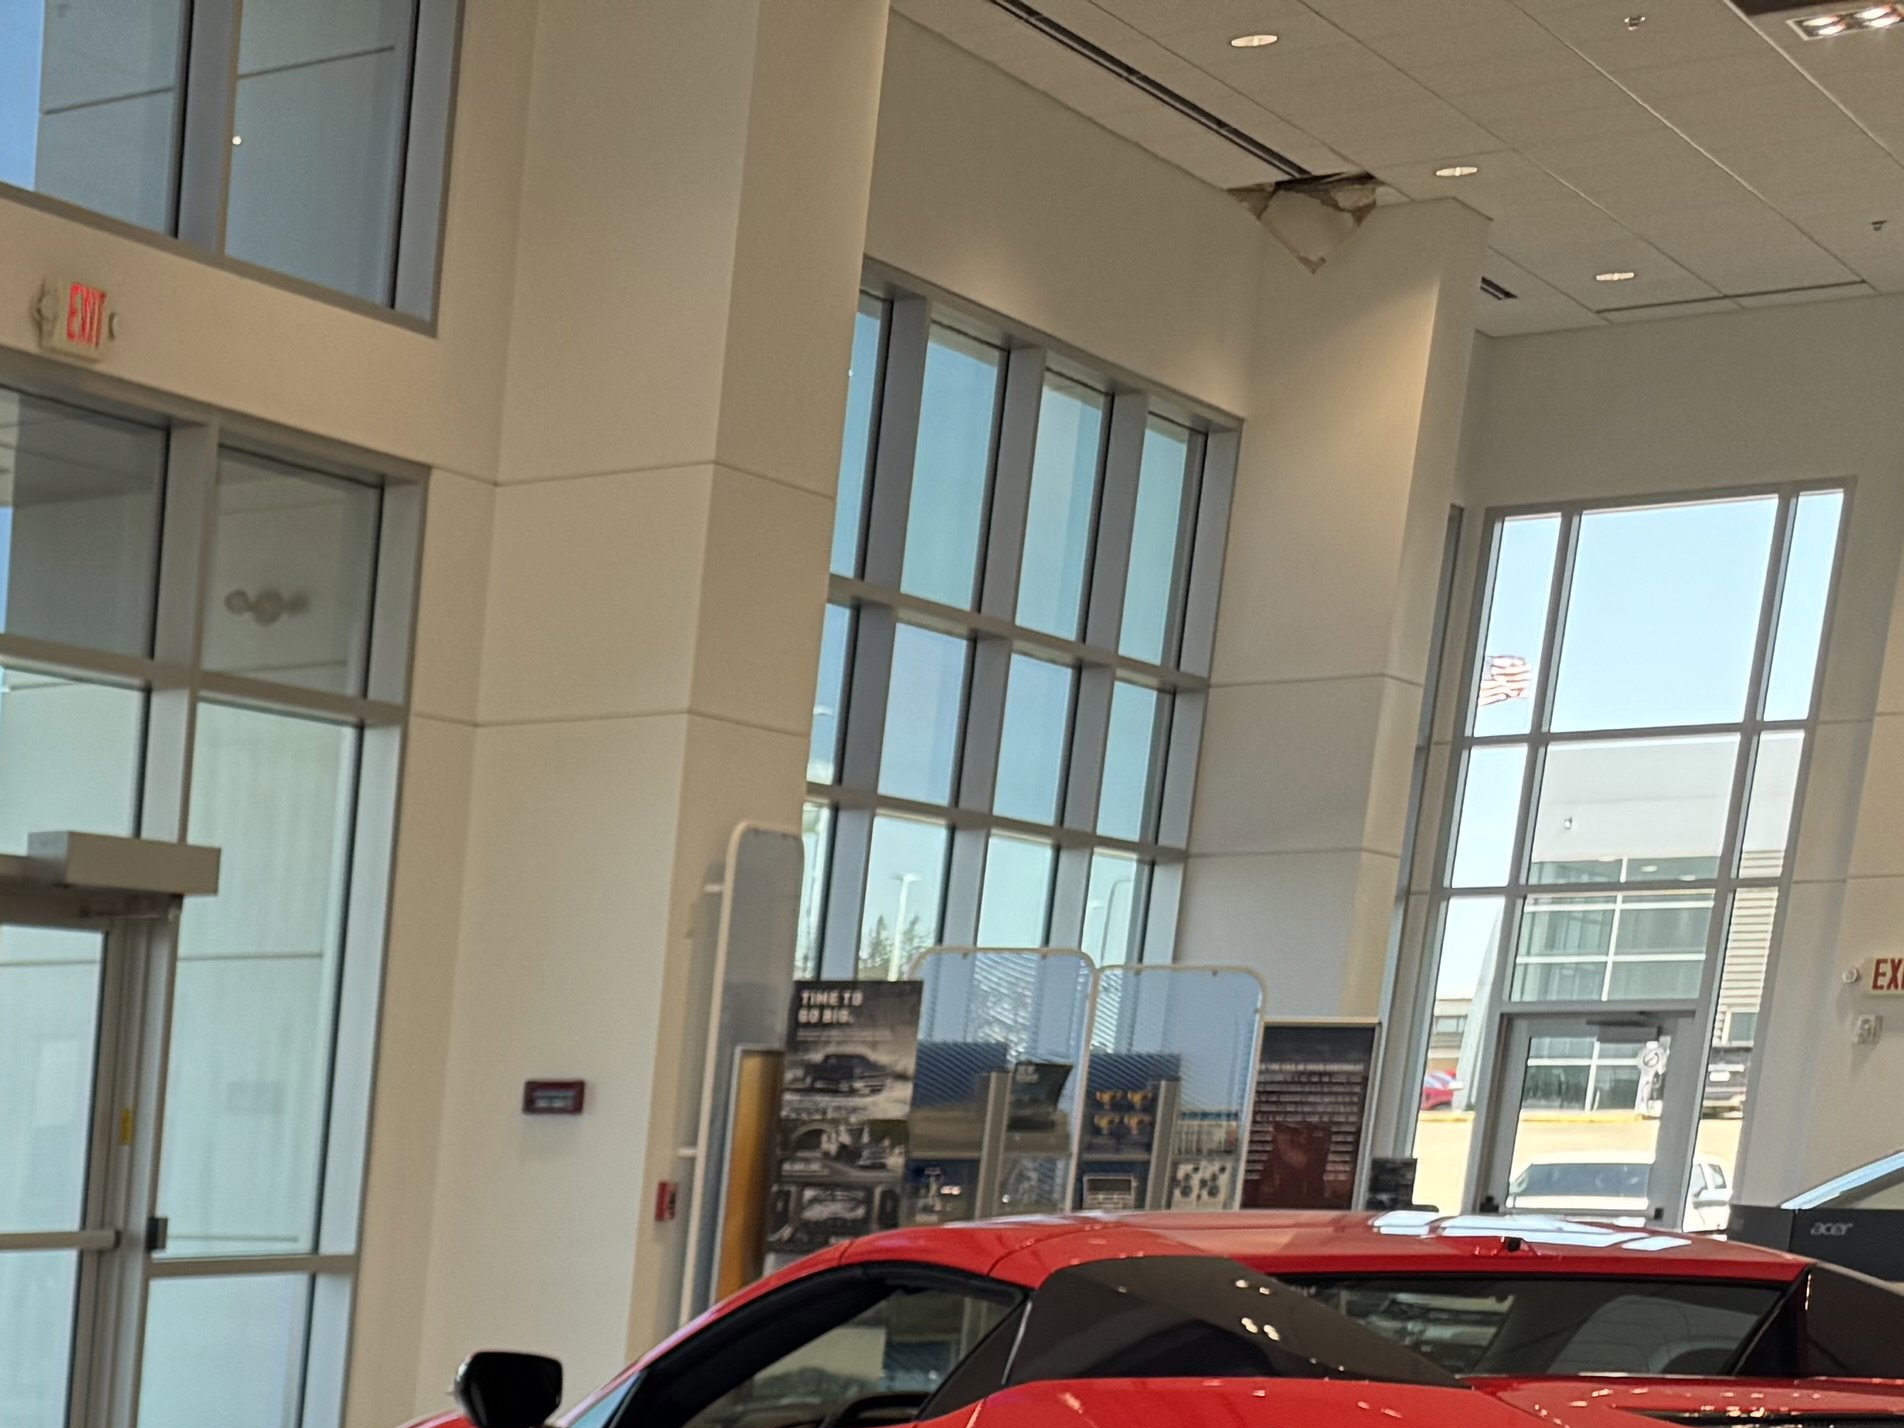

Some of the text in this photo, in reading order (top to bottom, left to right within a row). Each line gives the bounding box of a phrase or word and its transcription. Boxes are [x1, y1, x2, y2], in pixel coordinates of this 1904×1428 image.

[1872, 958, 1904, 991] EX
[800, 989, 863, 1006] TIME TO
[1810, 1222, 1854, 1236] acer
